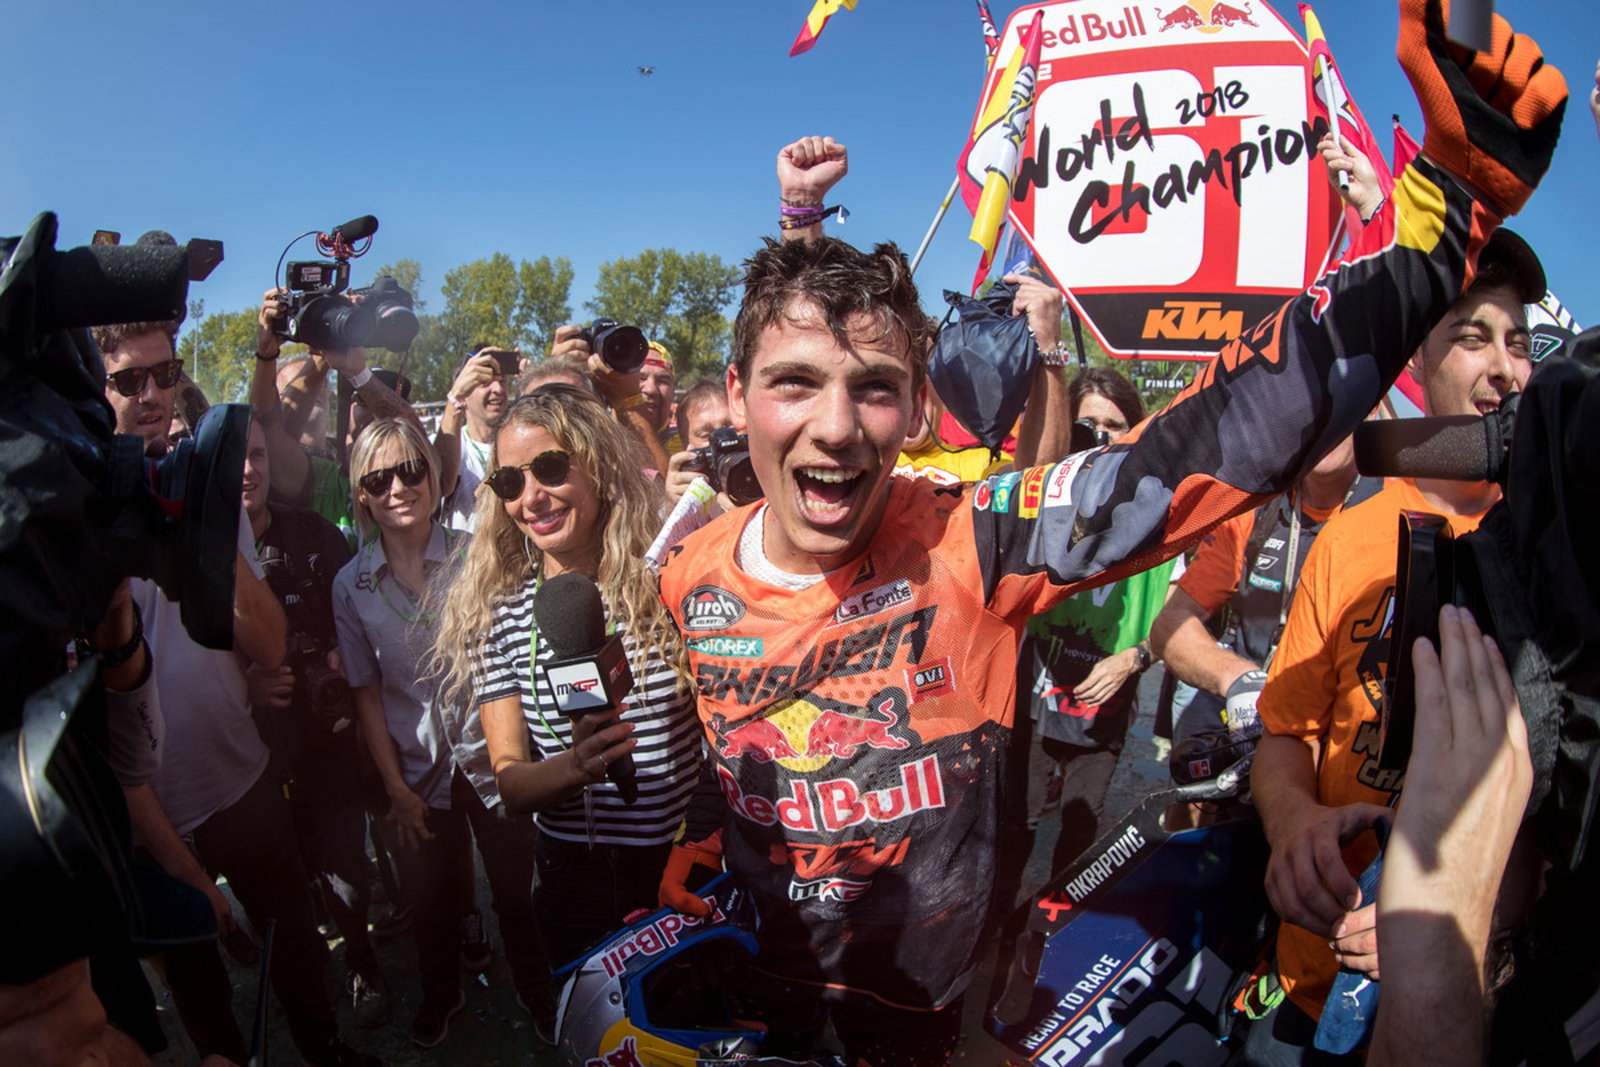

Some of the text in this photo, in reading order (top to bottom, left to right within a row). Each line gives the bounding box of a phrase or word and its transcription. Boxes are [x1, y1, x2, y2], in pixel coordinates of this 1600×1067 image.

[1082, 6, 1146, 42] Bull
[1175, 80, 1250, 126] 2018
[1068, 116, 1331, 244] Champion
[1142, 301, 1244, 341] KTM
[1145, 379, 1184, 389] FINISH
[687, 638, 758, 656] OTOREX
[716, 753, 946, 833] Red Bull
[600, 924, 667, 979] Bull
[1021, 954, 1121, 1050] READY TO RACE
